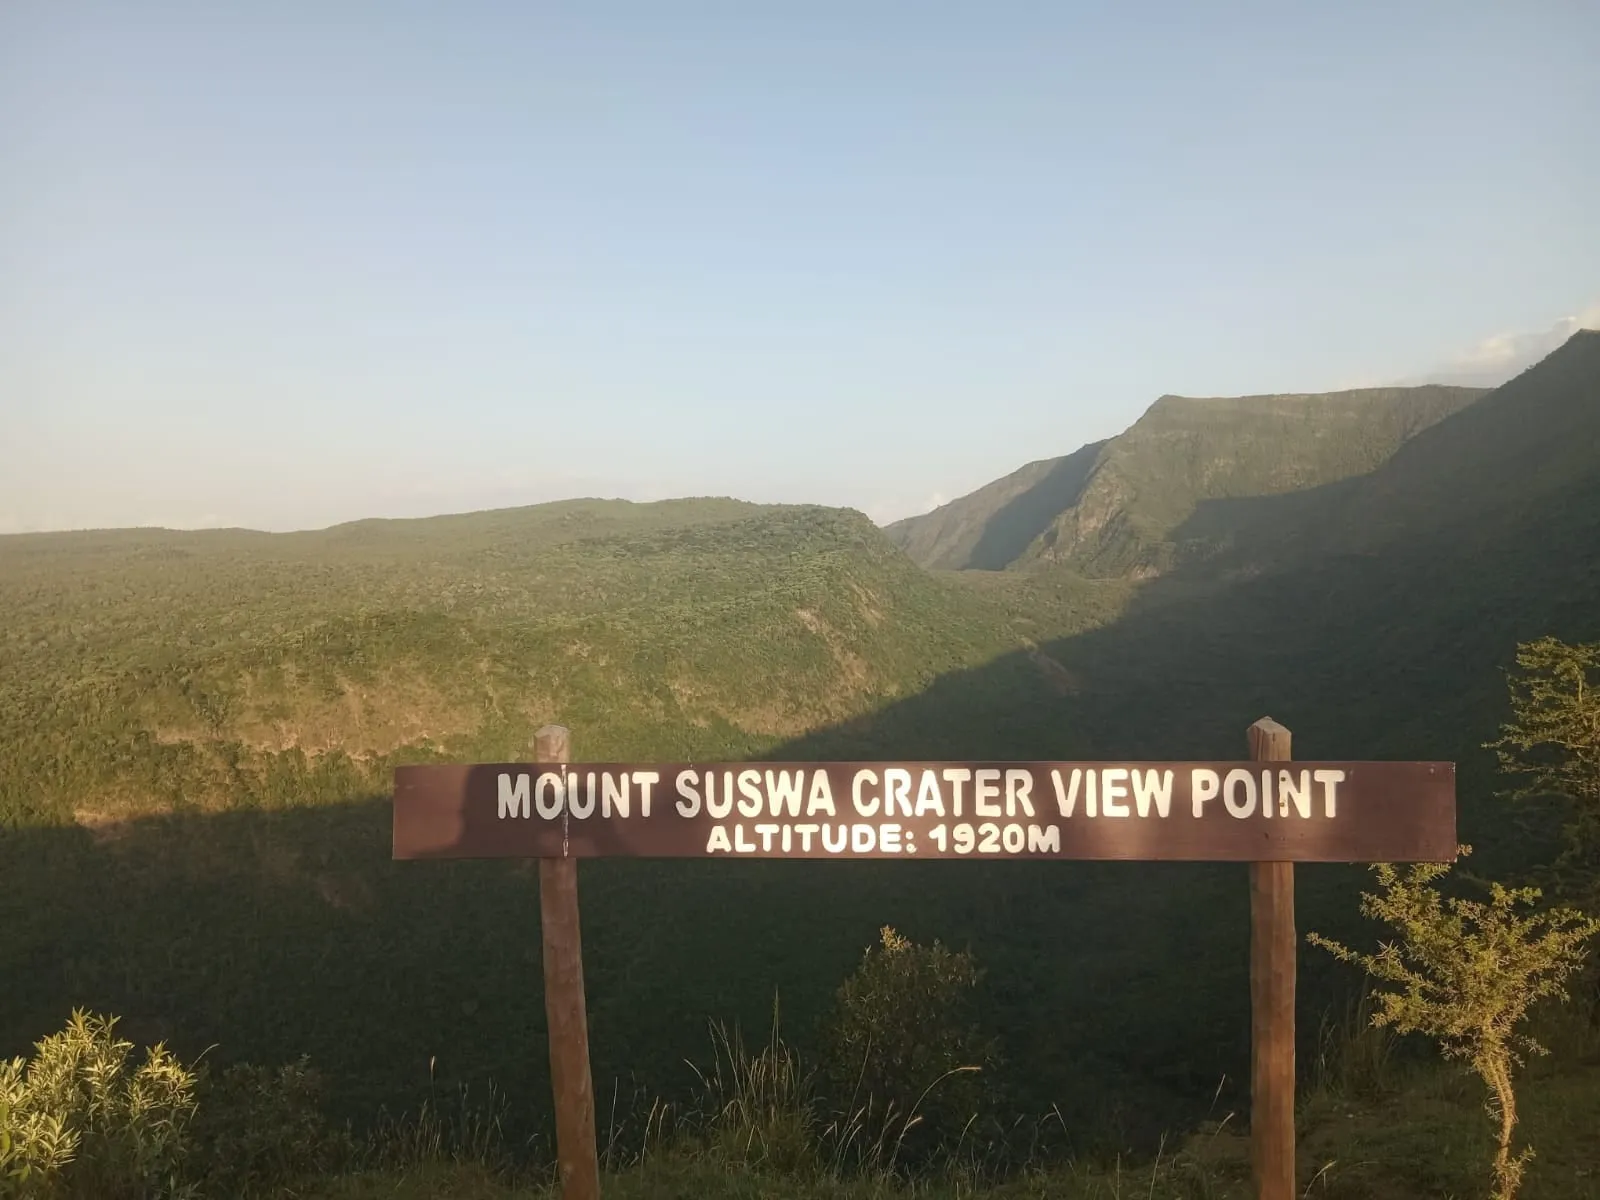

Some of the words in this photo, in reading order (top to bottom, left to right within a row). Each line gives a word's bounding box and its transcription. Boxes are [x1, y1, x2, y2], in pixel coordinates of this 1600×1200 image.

[496, 771, 661, 820] MOUNT
[675, 769, 838, 819] SUSWA
[851, 767, 1036, 819] CRATER
[1050, 768, 1176, 819] VIEW
[1191, 769, 1347, 820] POINT
[705, 823, 918, 855] ALTITUDE:
[927, 822, 1062, 855] 1920M
